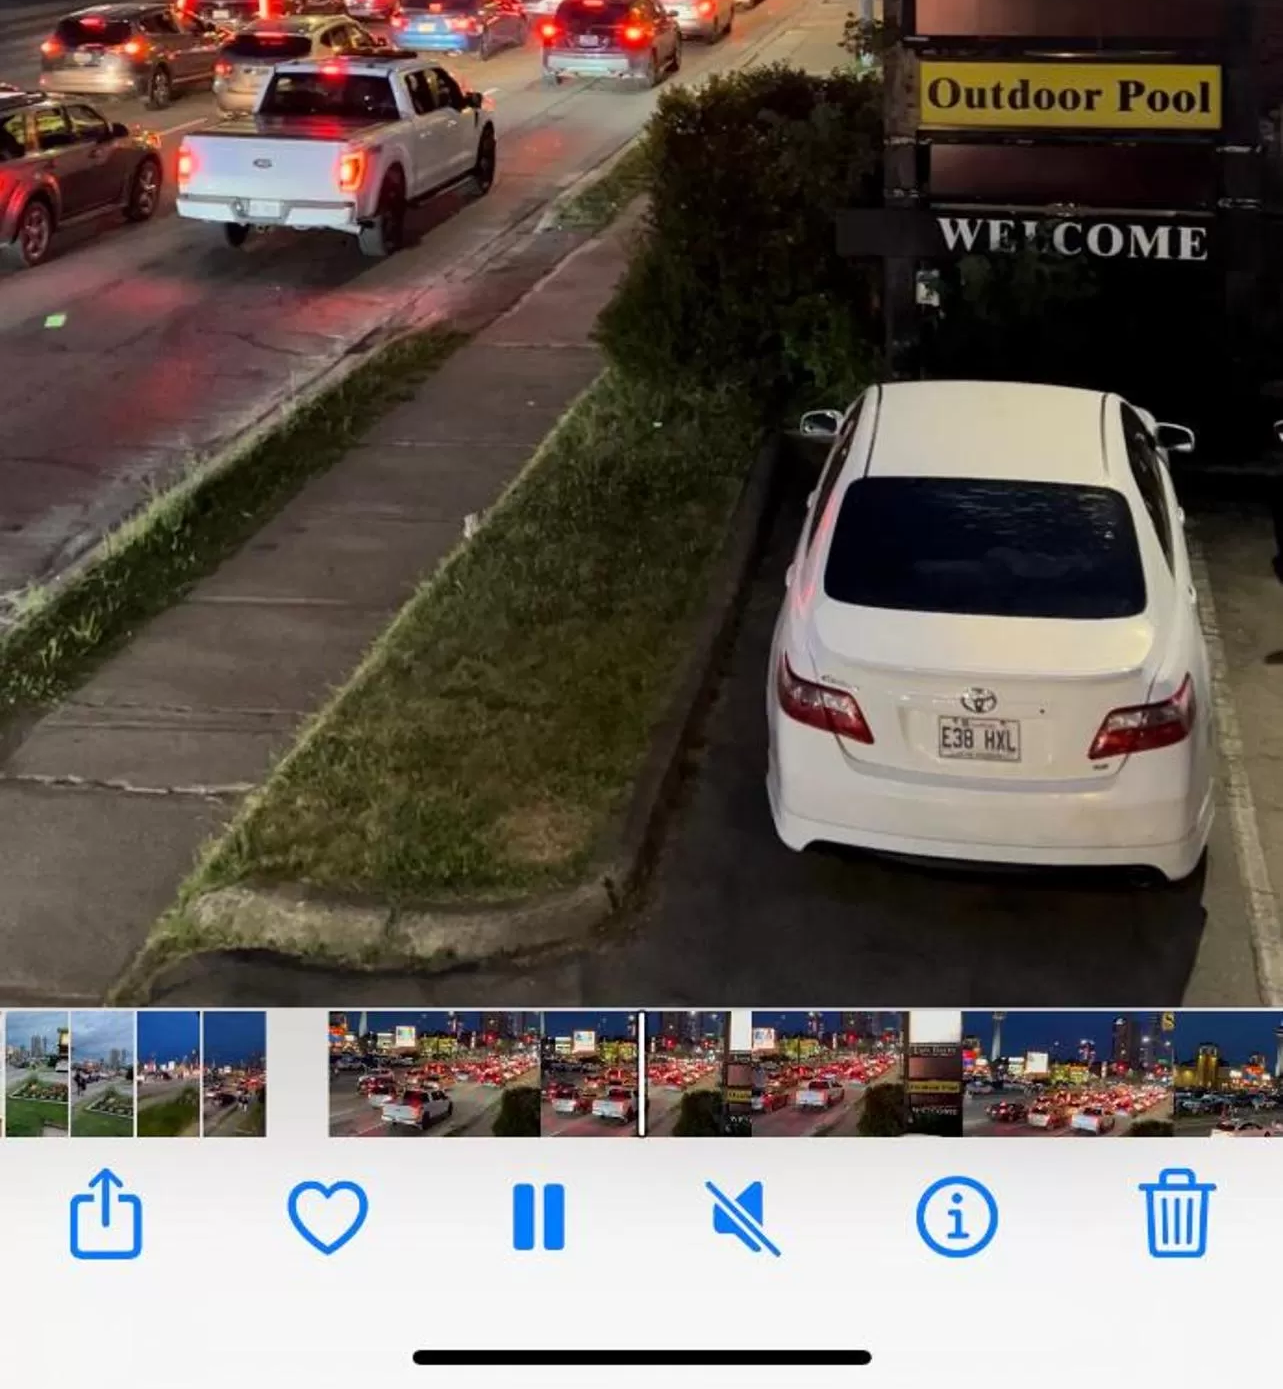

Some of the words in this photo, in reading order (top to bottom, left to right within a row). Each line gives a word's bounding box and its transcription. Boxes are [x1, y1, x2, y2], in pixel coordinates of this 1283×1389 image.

[928, 77, 1103, 112] Outdoor
[1118, 80, 1211, 114] Pool
[936, 217, 1208, 261] WELCOME
[984, 729, 1016, 752] HXL
